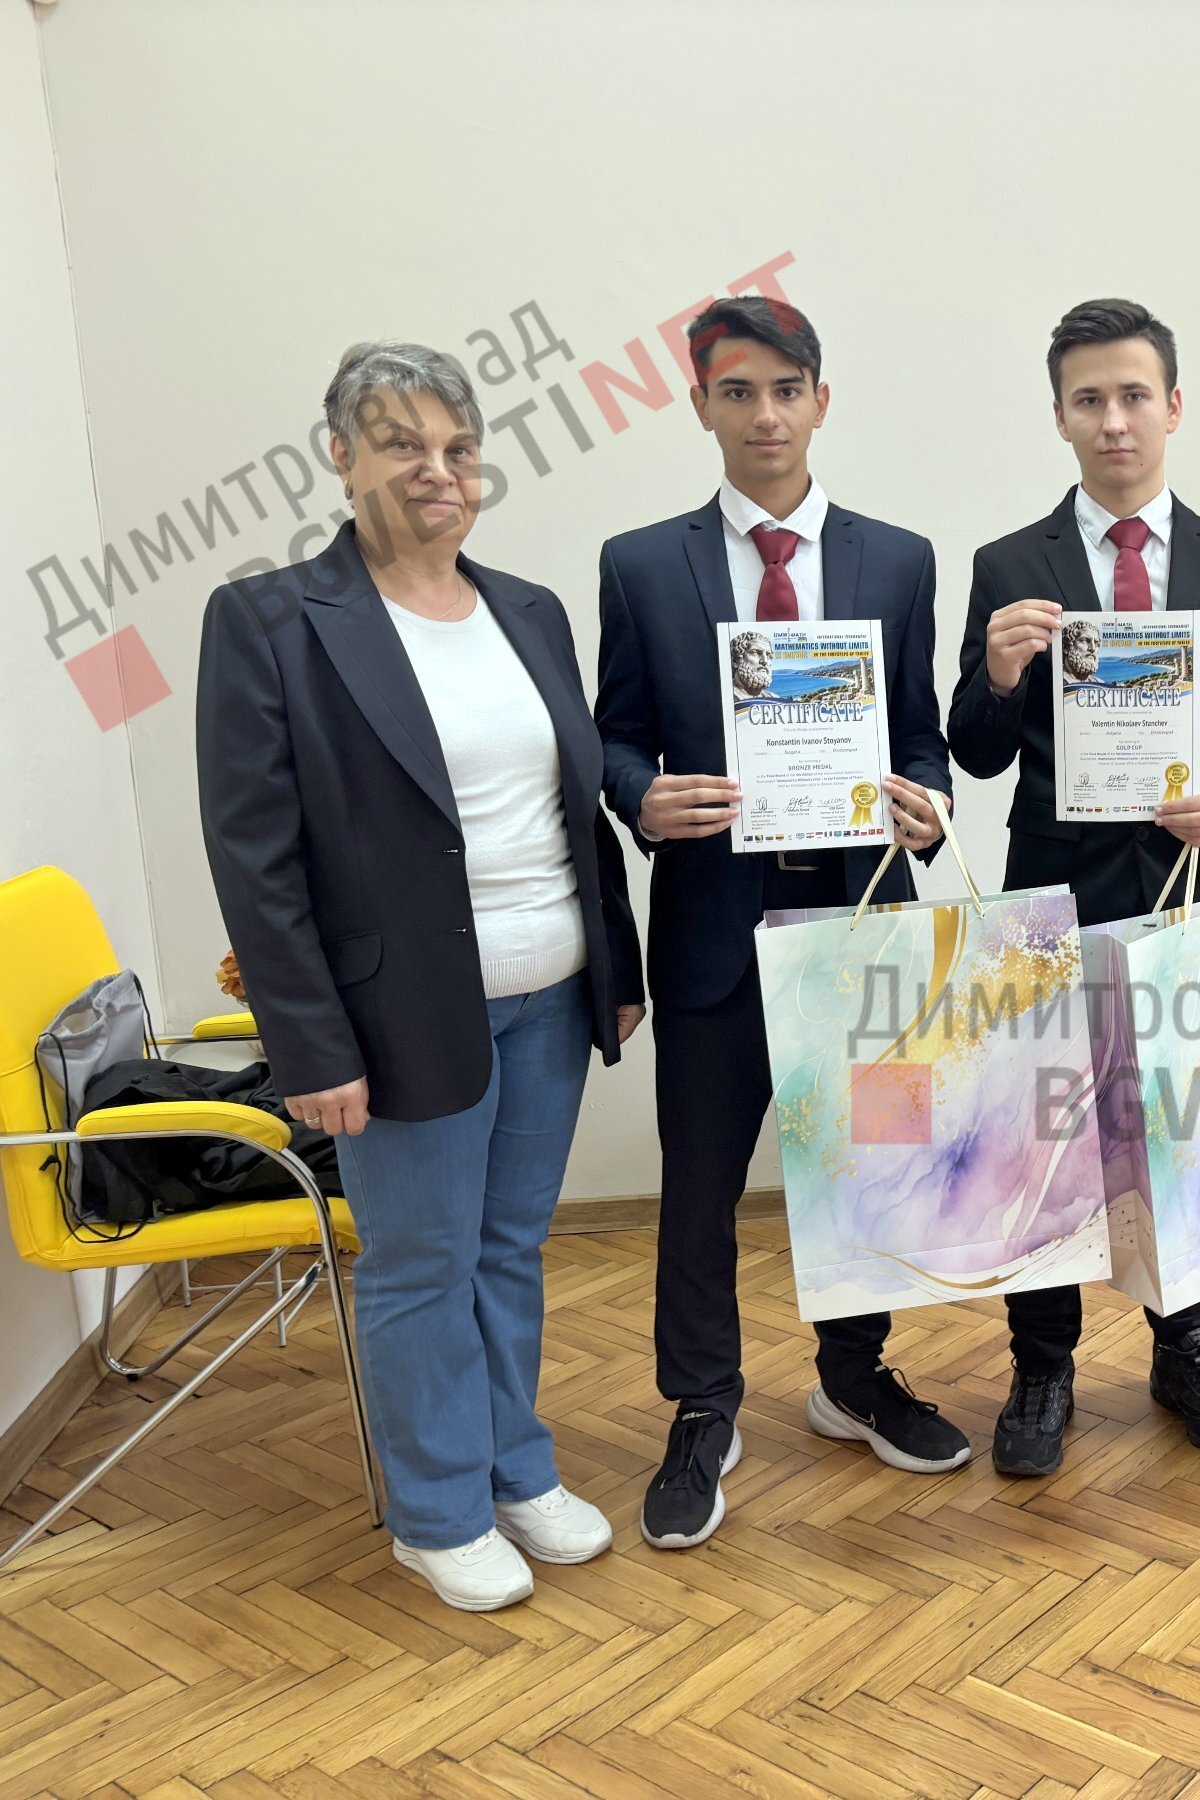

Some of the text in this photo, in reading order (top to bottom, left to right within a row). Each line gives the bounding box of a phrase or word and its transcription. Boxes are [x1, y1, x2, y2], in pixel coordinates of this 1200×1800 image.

[774, 641, 869, 651] MATHEMATICS WITHOUT LIMITS
[1076, 688, 1181, 708] CERTIFICATE
[748, 702, 864, 726] CERTIFICATE
[1091, 720, 1115, 728] Valentin
[1141, 719, 1168, 727] Stanchev
[766, 736, 852, 747] Konstantin Ivanov Stoyanov
